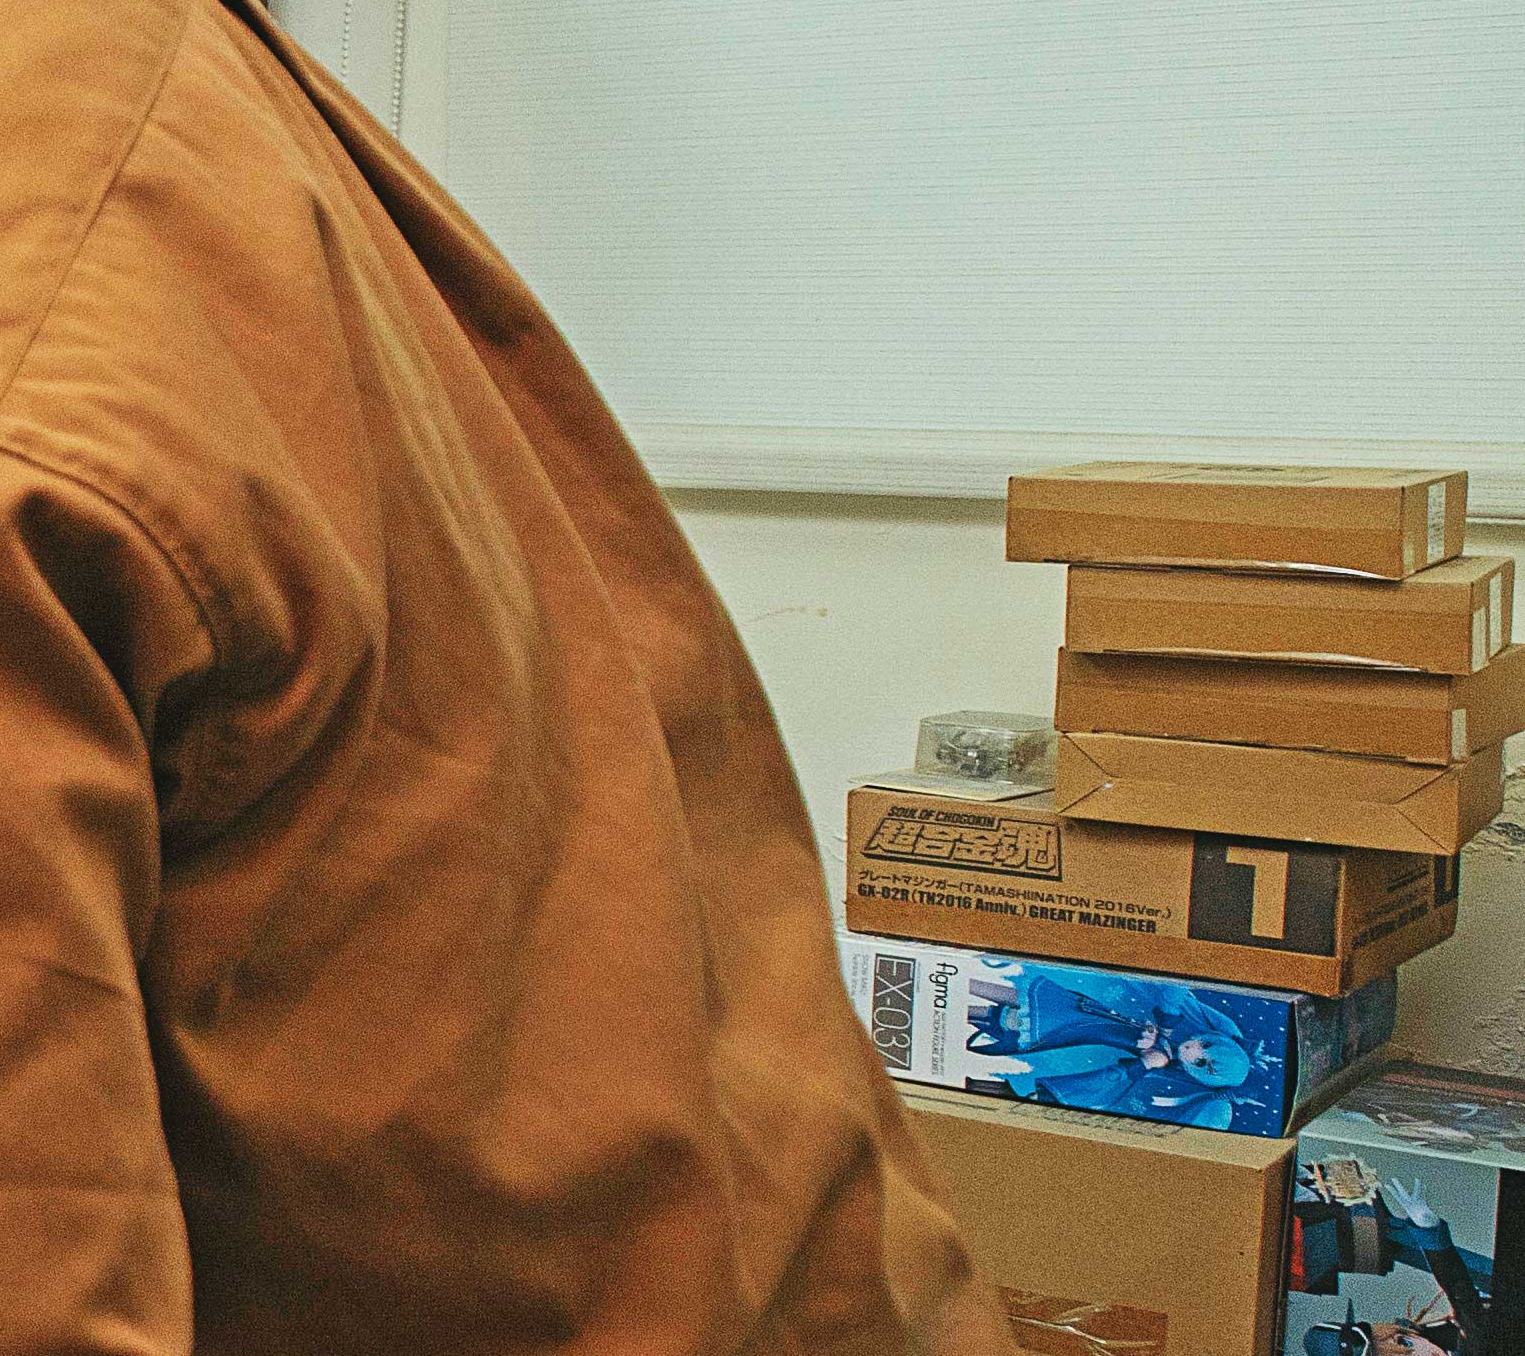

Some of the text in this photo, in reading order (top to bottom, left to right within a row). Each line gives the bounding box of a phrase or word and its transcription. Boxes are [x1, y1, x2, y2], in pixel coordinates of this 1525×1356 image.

[887, 805, 996, 828] SOUL OF CHOGOKIN
[866, 818, 1059, 873] 超合金魂
[1028, 905, 1075, 925] GREAT
[1078, 912, 1157, 935] MAZINGER
[929, 962, 959, 1010] figma
[873, 955, 914, 1068] EX-037
